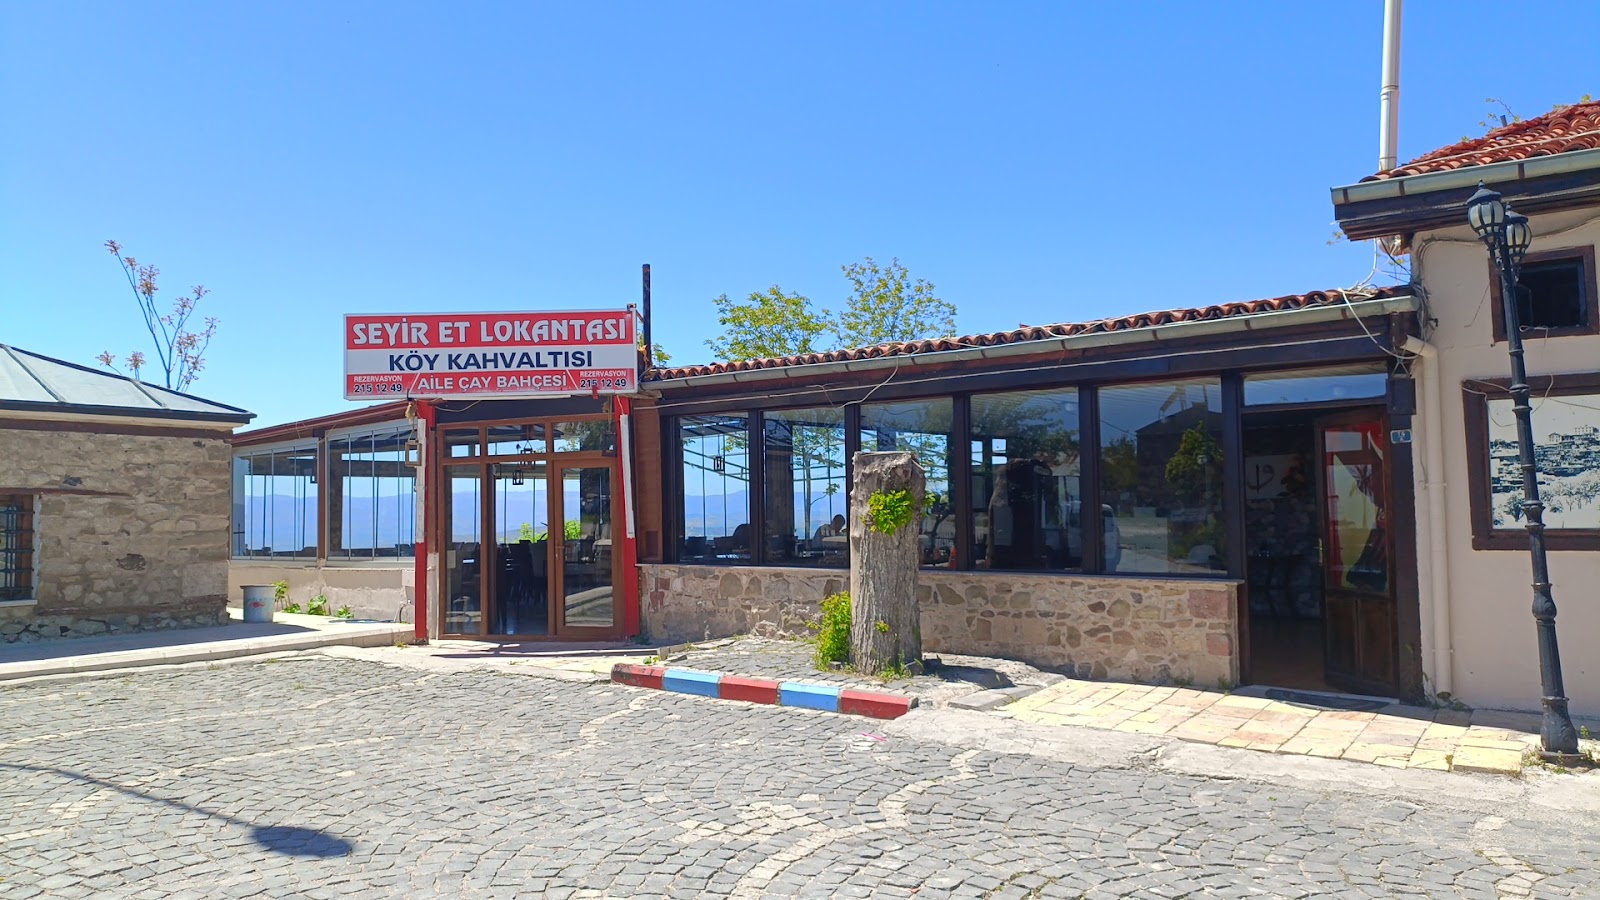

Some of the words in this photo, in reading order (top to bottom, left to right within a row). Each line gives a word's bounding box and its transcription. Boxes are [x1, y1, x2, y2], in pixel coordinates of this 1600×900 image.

[353, 317, 430, 347] SEYİR
[438, 321, 471, 343] ET
[480, 318, 626, 343] LOKANTASI
[389, 350, 440, 371] KÖY
[447, 350, 592, 370] KAHVALTISI
[354, 383, 373, 393] 215
[376, 383, 388, 392] 12
[390, 382, 403, 392] 49
[417, 375, 454, 390] AİLE
[458, 376, 492, 392] ÇAY
[496, 372, 567, 391] BAHÇESİ
[580, 379, 598, 388] 215
[601, 378, 612, 387] 12
[614, 378, 627, 387] 49
